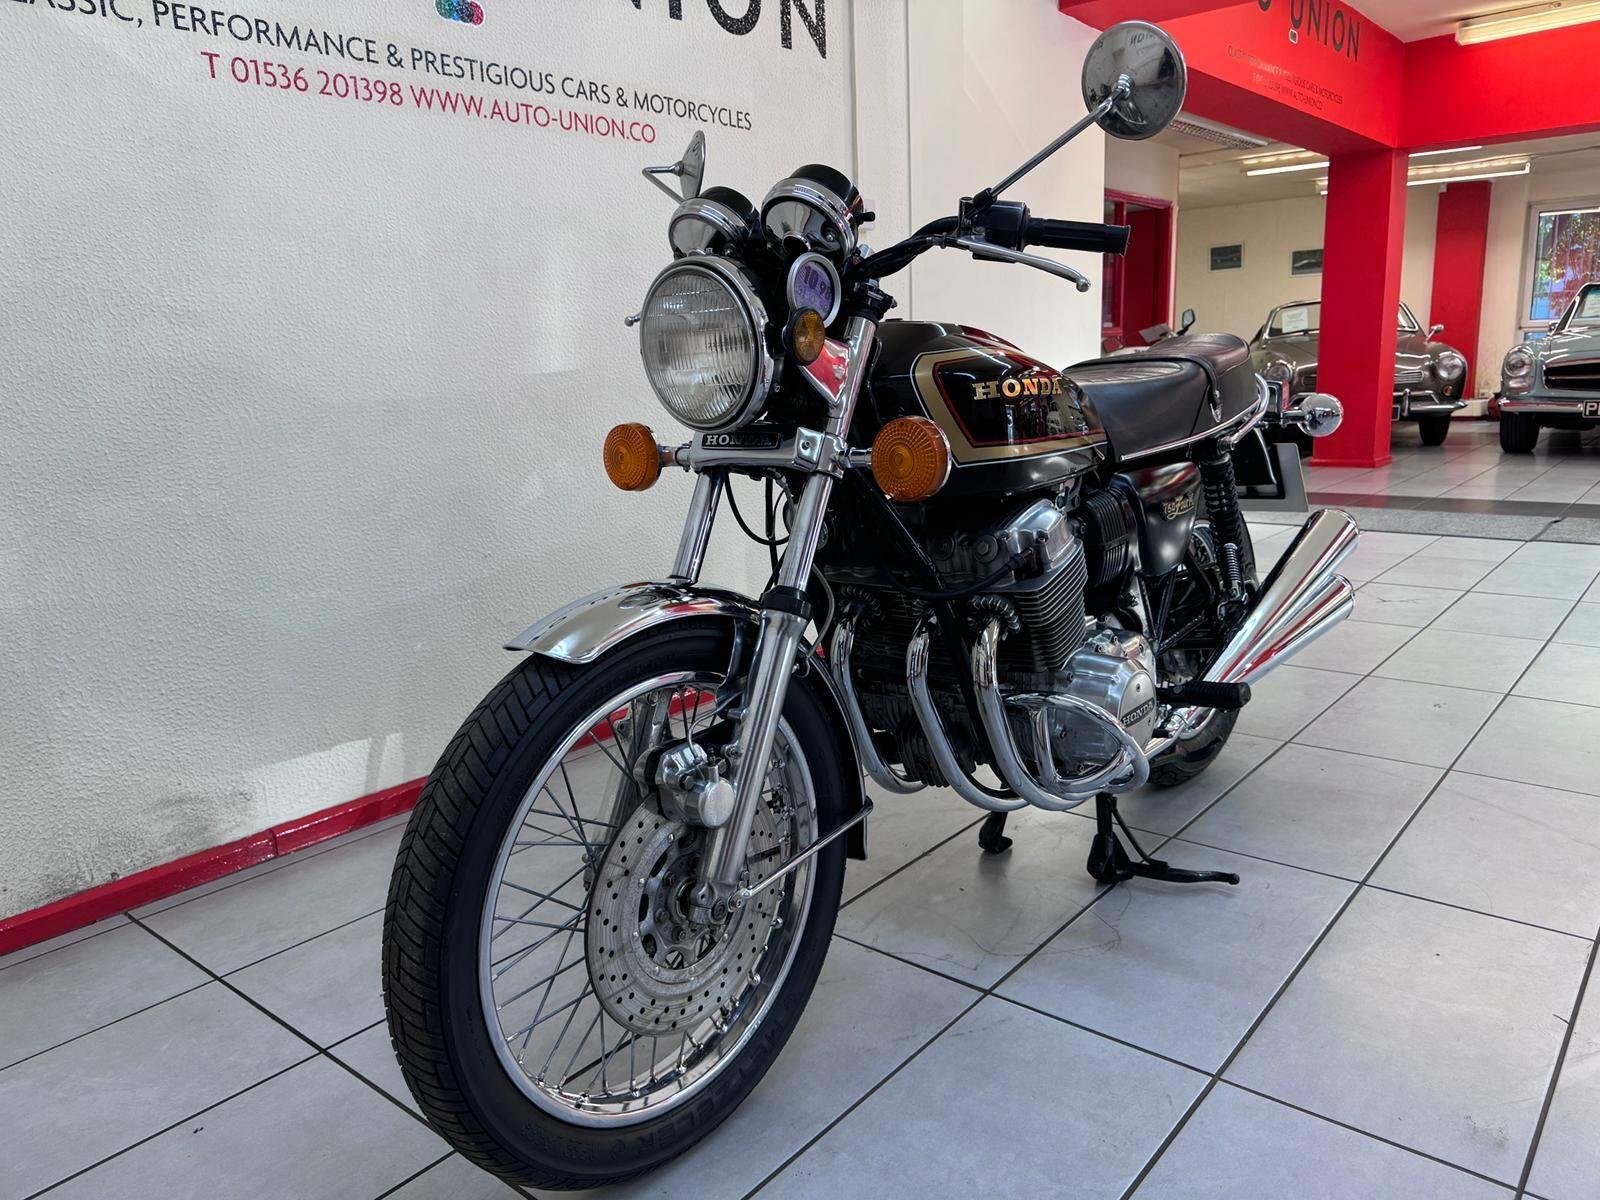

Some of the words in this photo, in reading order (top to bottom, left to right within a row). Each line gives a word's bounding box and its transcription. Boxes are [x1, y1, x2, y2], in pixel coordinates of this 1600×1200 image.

[1290, 0, 1360, 62] UNION
[152, 0, 379, 64] PERFORMANCE
[386, 43, 404, 69] &
[411, 47, 555, 95] PRESTIGIOUS
[561, 77, 610, 104] CARS
[616, 87, 628, 108] &
[634, 90, 752, 131] MOTORCYCLES
[200, 51, 220, 79] T
[231, 56, 309, 92] 01536
[317, 70, 403, 106] 201398
[409, 84, 655, 143] WWW.AUTO-UNION.CO
[972, 377, 1062, 400] HONDA
[1586, 402, 1600, 416] P
